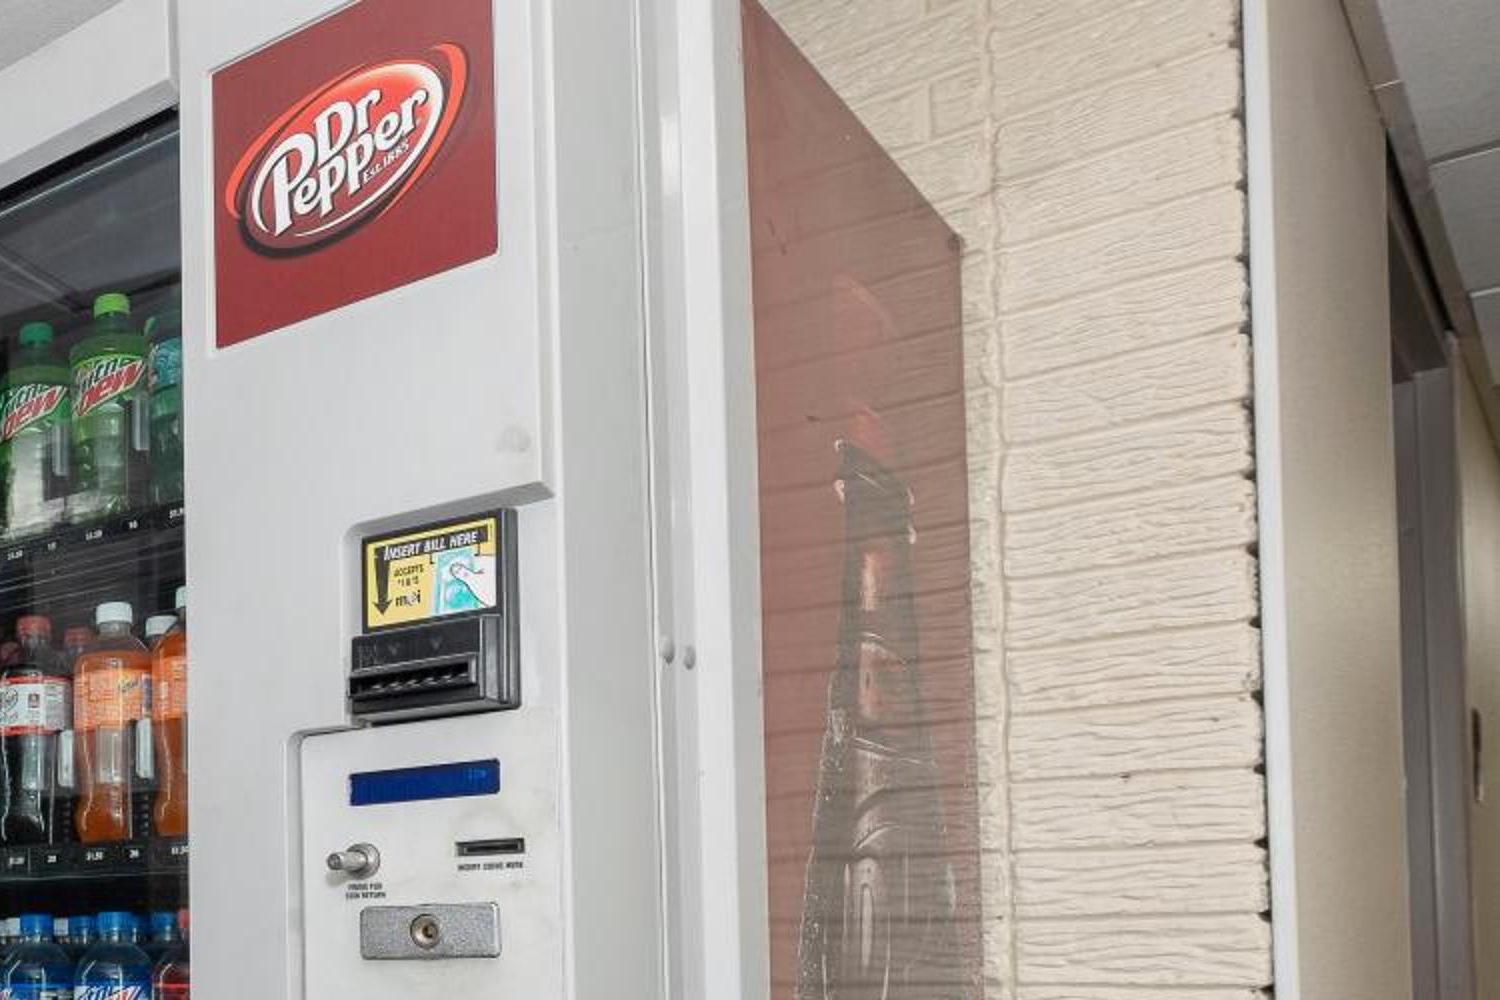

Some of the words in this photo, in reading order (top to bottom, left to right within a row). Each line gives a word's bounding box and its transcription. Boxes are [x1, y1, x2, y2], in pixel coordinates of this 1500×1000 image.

[252, 88, 429, 238] Pepper
[313, 88, 382, 168] Dr
[383, 541, 422, 561] INSERT
